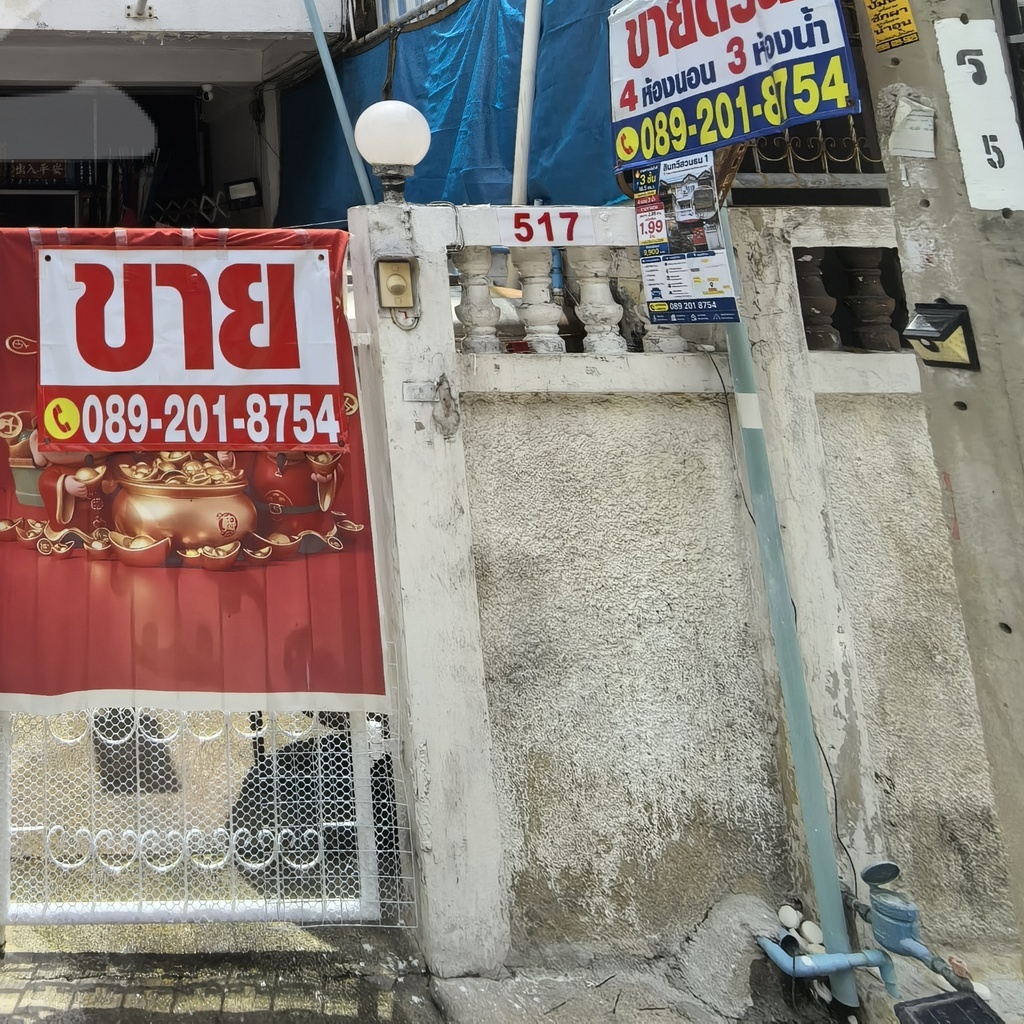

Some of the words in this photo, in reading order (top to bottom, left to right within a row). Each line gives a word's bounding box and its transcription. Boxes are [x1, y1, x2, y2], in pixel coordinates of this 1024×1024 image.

[619, 79, 638, 112] 4
[642, 61, 717, 108] ห้องนอน
[726, 36, 747, 75] 3
[752, 6, 830, 66] ห้องน้ำ
[640, 55, 850, 160] 089-201-8754
[704, 154, 709, 163] 1
[982, 134, 1005, 169] 5
[15, 162, 64, 175] 出入平安
[640, 175, 646, 185] 3
[513, 211, 579, 243] 517
[639, 219, 664, 236] 1.99
[74, 263, 301, 372] ขาย
[669, 301, 683, 310] 089
[684, 301, 697, 310] 201
[697, 300, 717, 310] 8754
[82, 393, 340, 444] 089-201-8754
